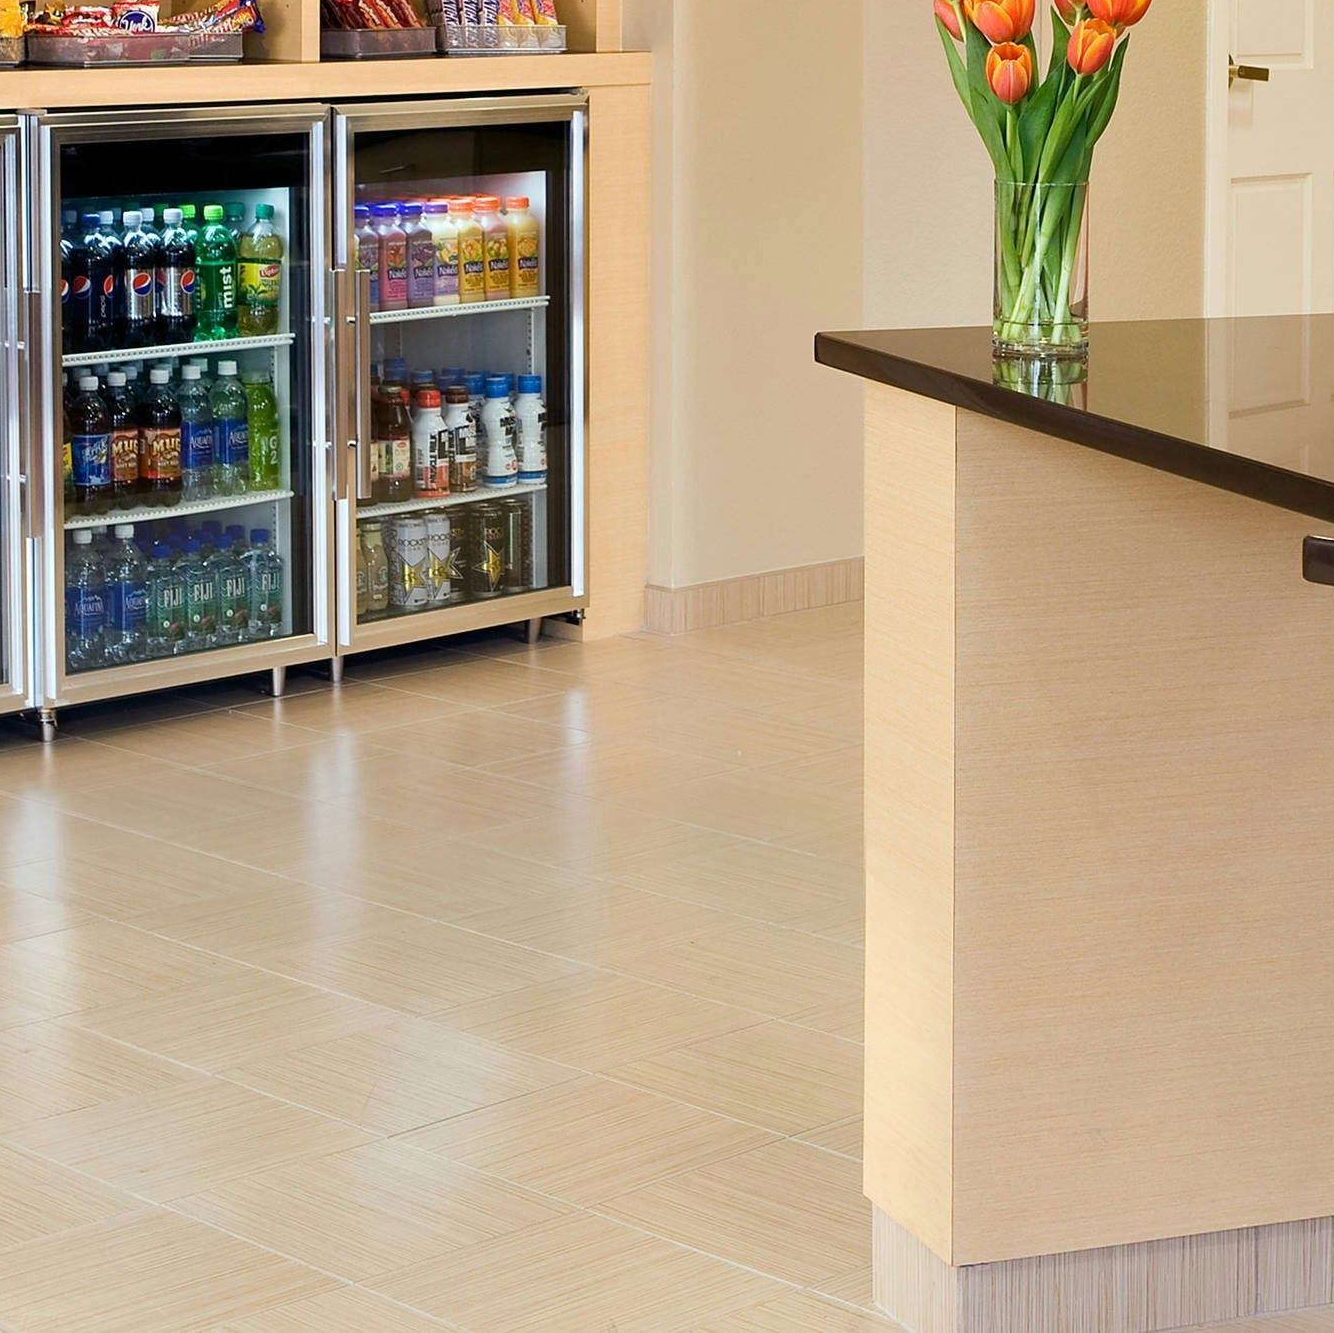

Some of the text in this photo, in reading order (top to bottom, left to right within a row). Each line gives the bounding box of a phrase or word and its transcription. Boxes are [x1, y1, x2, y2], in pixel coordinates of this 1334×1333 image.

[219, 266, 232, 308] mist
[194, 582, 213, 601] FIJI
[226, 577, 245, 597] FIJI
[262, 573, 279, 591] FIJI
[164, 587, 182, 607] FIJI
